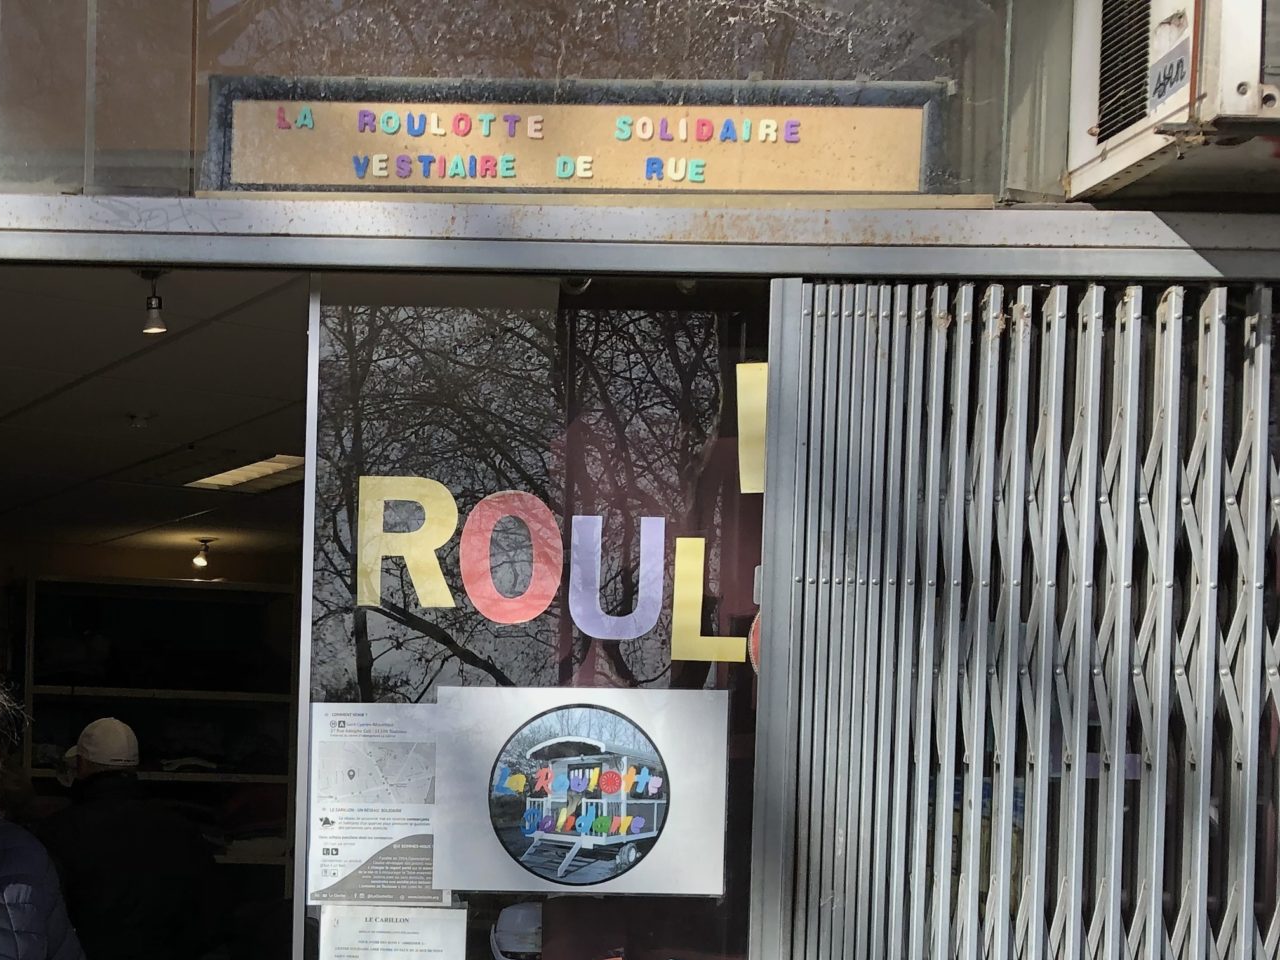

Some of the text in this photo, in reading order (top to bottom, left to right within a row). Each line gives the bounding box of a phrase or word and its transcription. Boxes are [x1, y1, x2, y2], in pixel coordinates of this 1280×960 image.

[276, 105, 802, 145] LA ROULOTTE SOLIDAIRE
[352, 153, 707, 184] VESTIAIRE DE RUE
[356, 475, 762, 675] ROUL
[494, 766, 663, 796] La Roulotte
